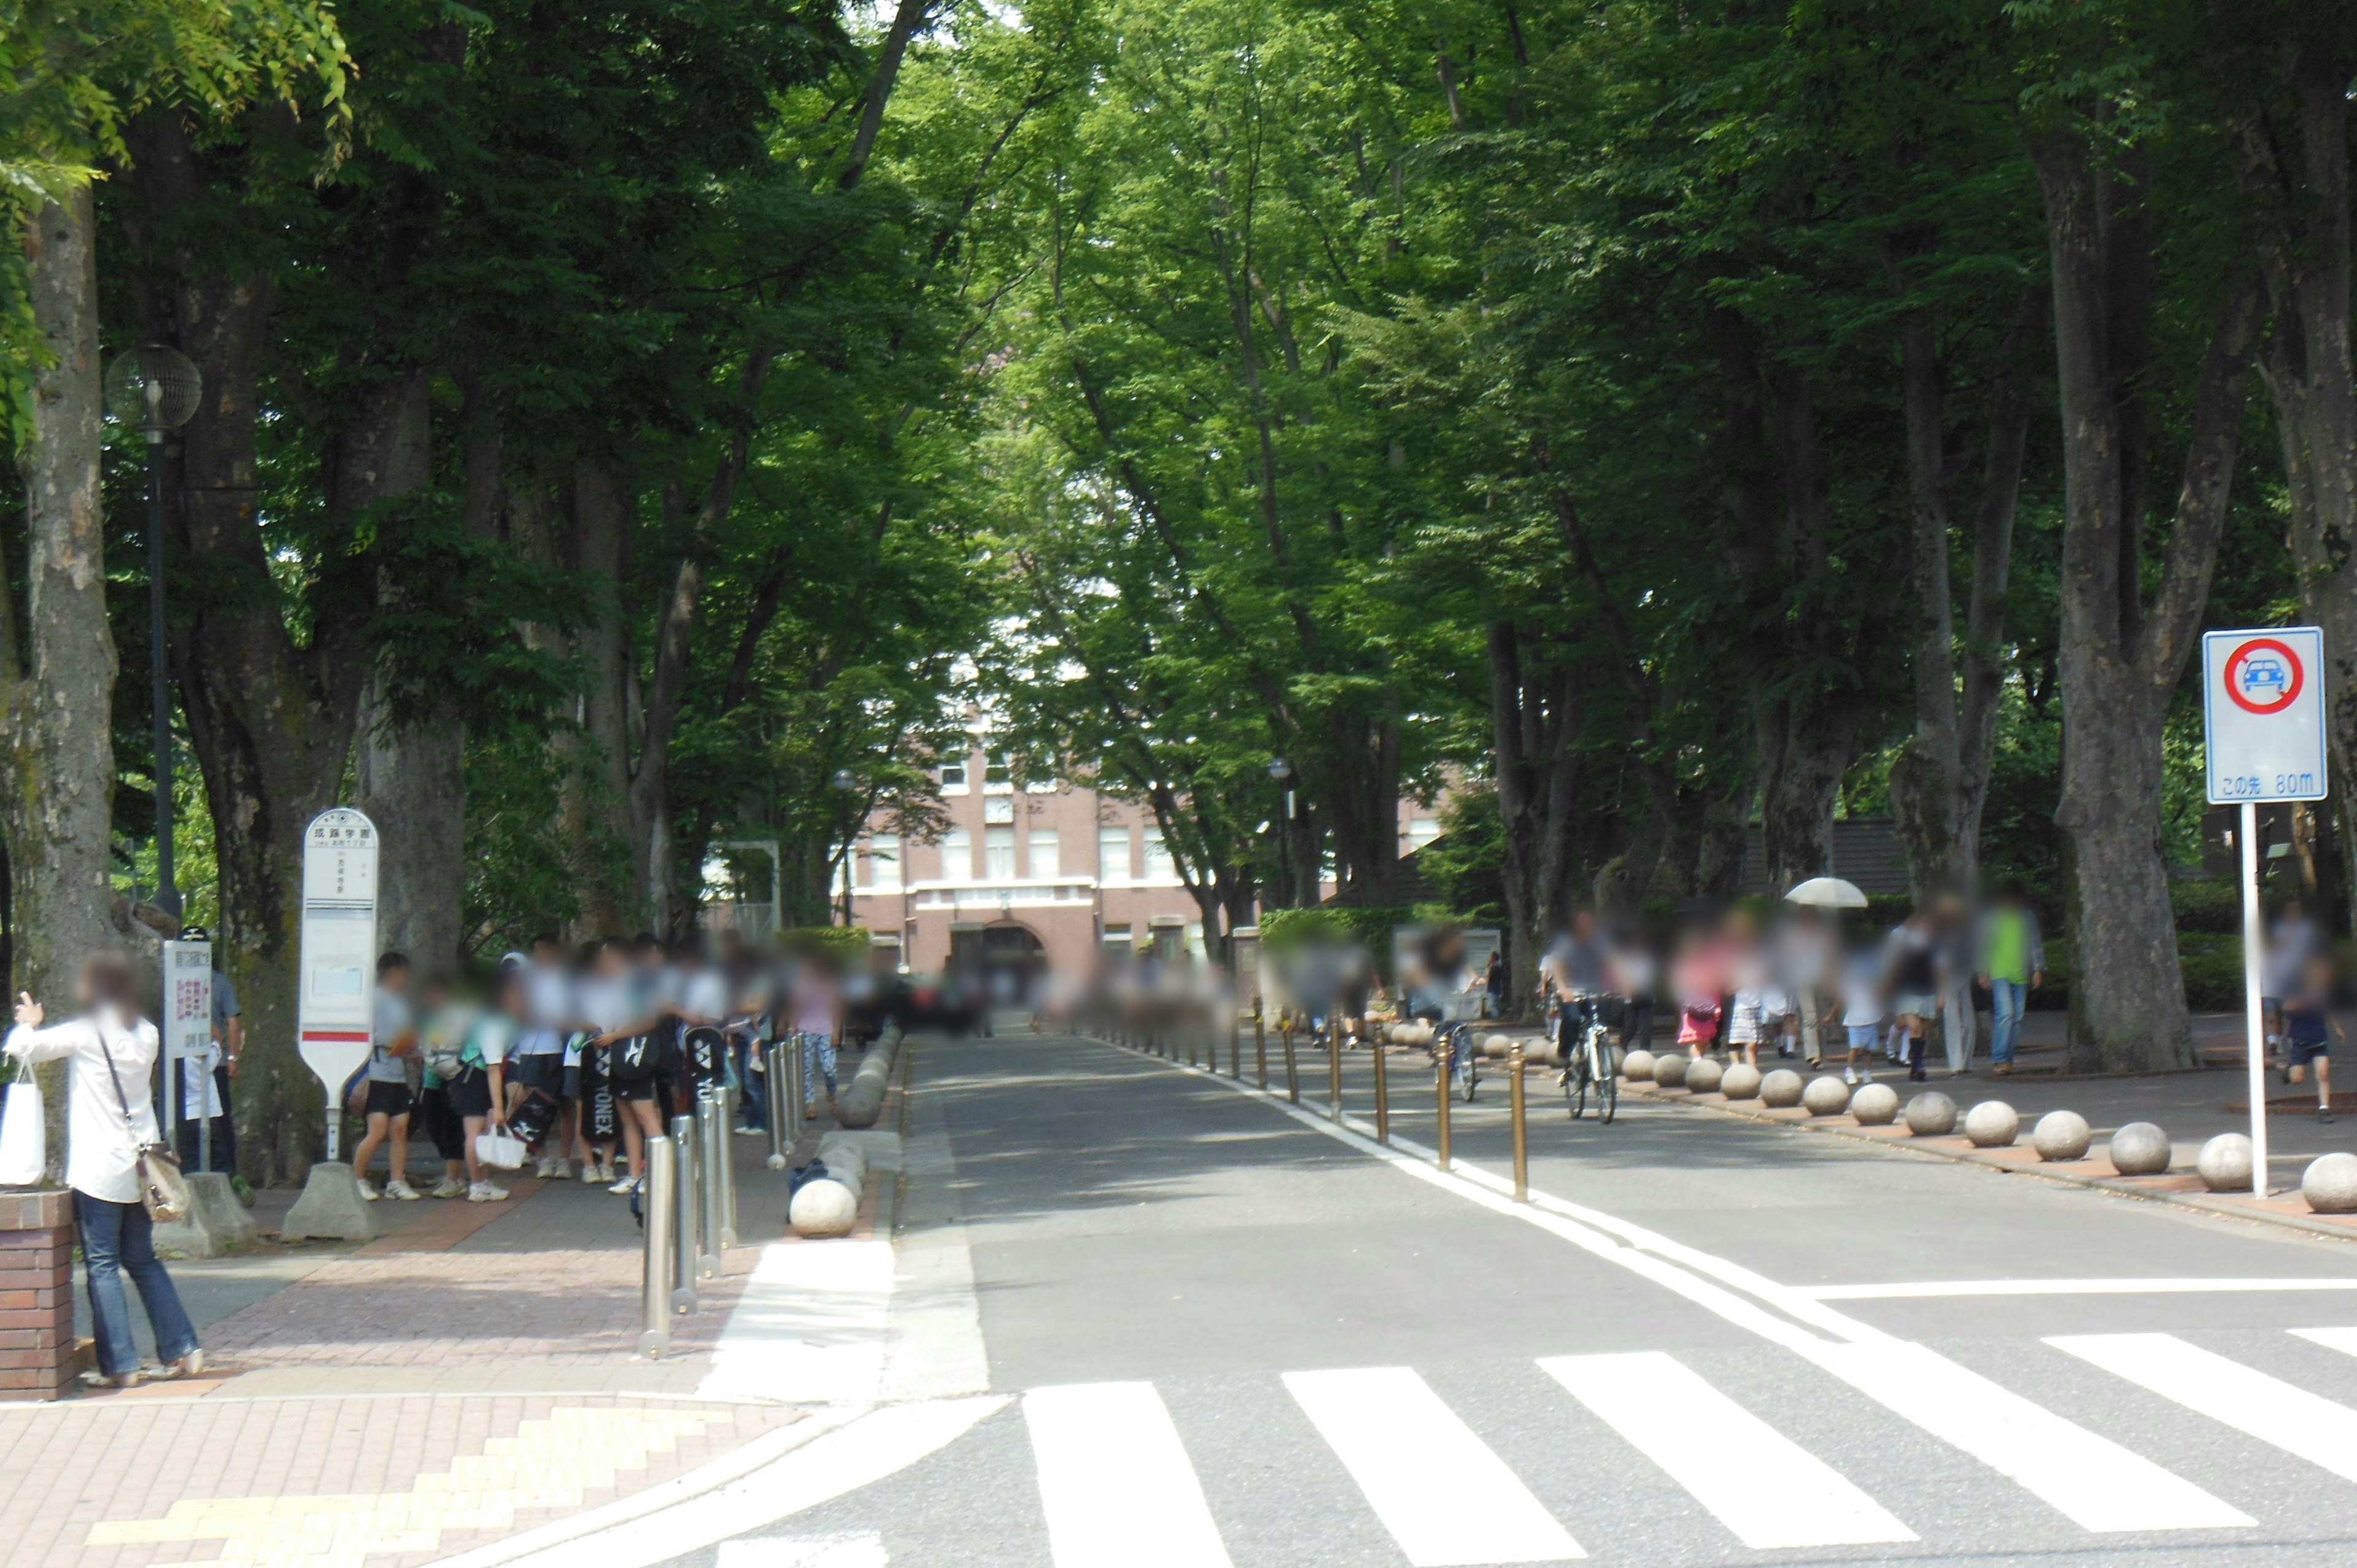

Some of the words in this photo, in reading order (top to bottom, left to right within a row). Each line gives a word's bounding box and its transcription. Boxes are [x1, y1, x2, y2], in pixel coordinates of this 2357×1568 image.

[2223, 776, 2261, 795] この先
[2276, 773, 2313, 794] 80m
[595, 1084, 613, 1134] YONEX
